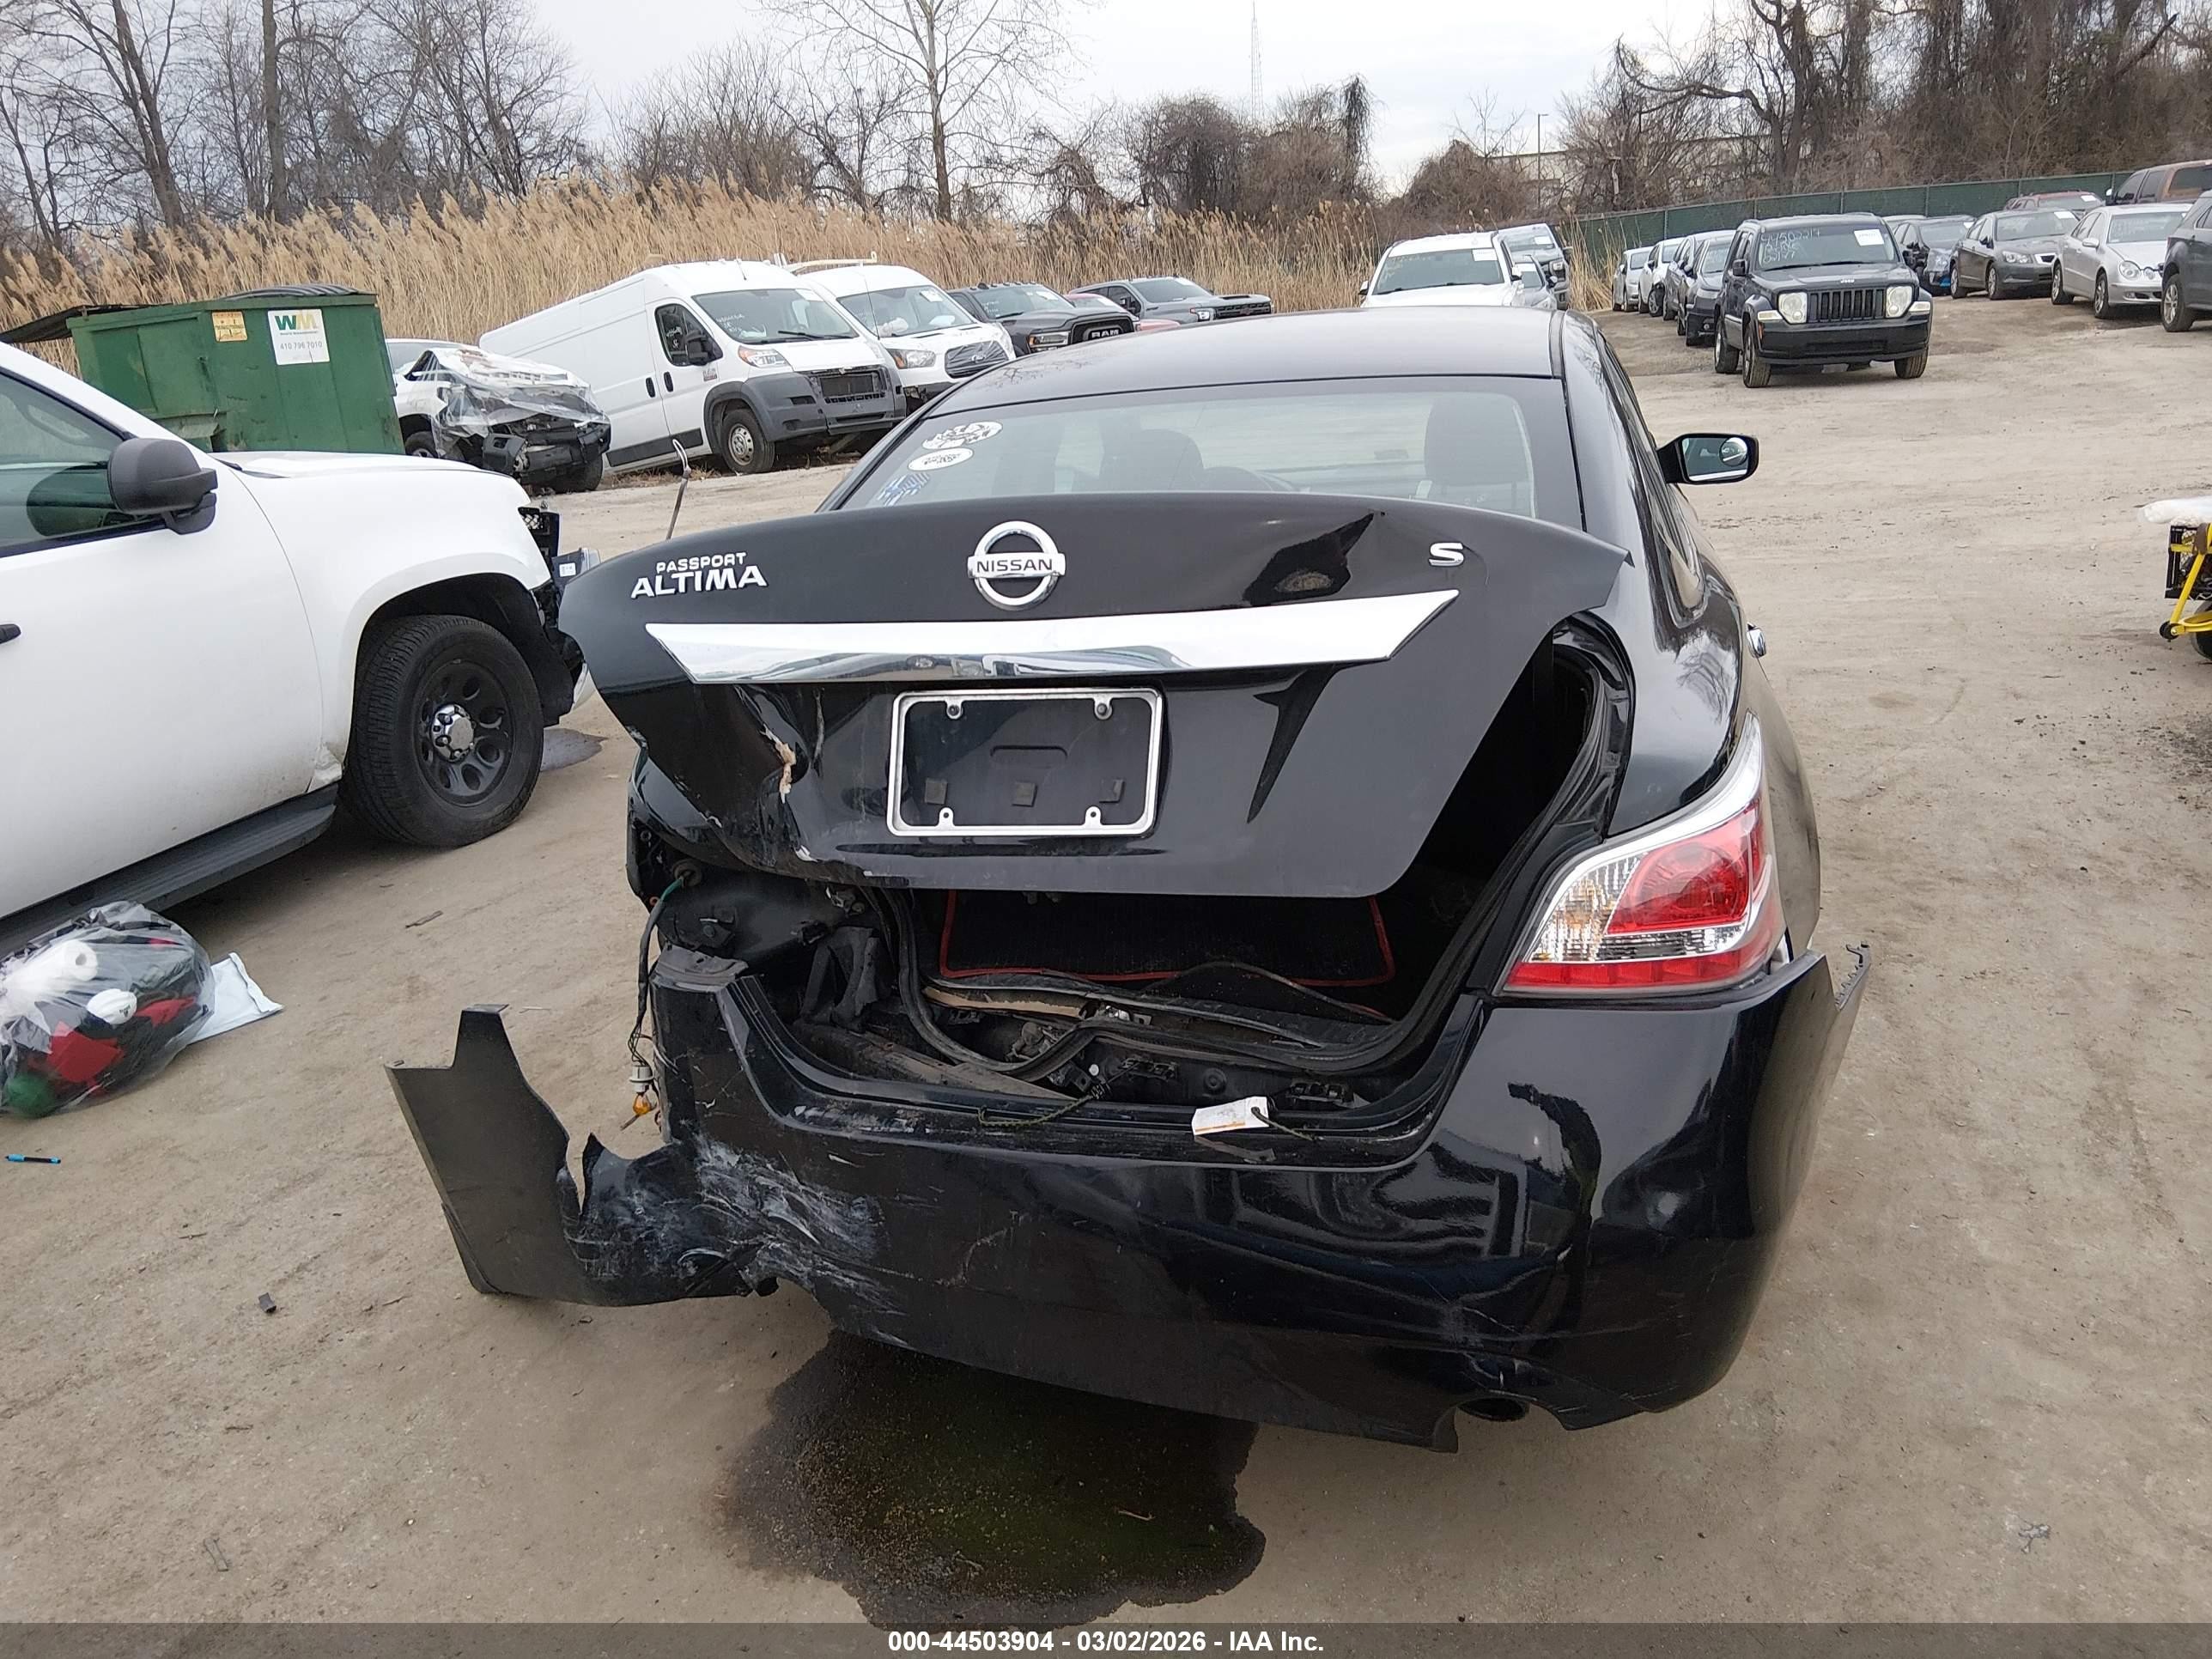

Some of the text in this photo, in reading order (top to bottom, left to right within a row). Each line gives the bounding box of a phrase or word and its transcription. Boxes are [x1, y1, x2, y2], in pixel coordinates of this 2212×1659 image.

[274, 314, 318, 331] WM
[1091, 329, 1120, 339] RAM
[307, 341, 323, 349] 7010
[656, 552, 747, 574] PASSPORT
[1428, 542, 1465, 567] S
[976, 558, 1053, 574] NISSAN
[630, 565, 769, 599] ALTIMA
